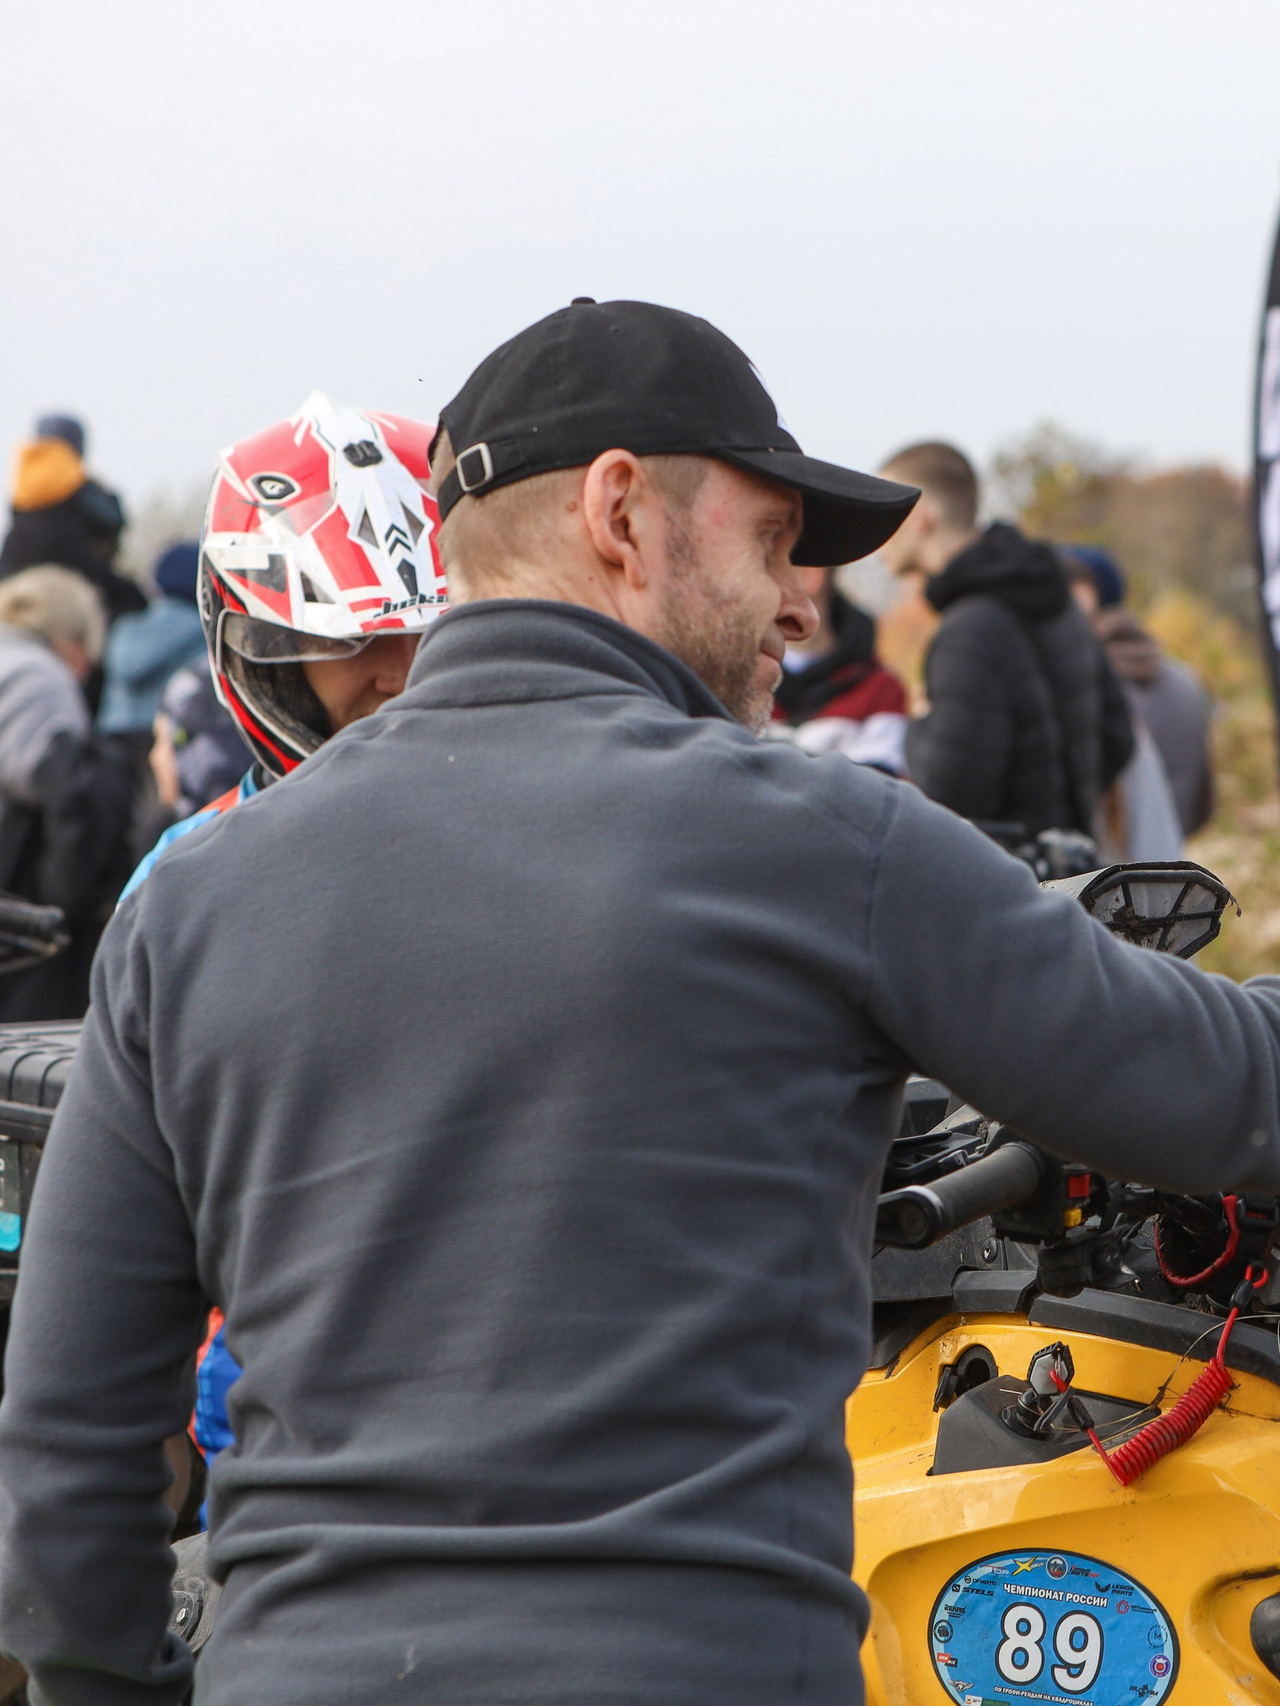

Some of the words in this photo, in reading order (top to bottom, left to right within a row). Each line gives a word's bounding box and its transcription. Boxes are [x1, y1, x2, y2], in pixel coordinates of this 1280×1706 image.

[962, 1587, 995, 1596] STELS
[1003, 1583, 1064, 1601] ЧЕМПИОНАТ
[1066, 1592, 1108, 1608] РОССИИ
[996, 1603, 1103, 1694] 89
